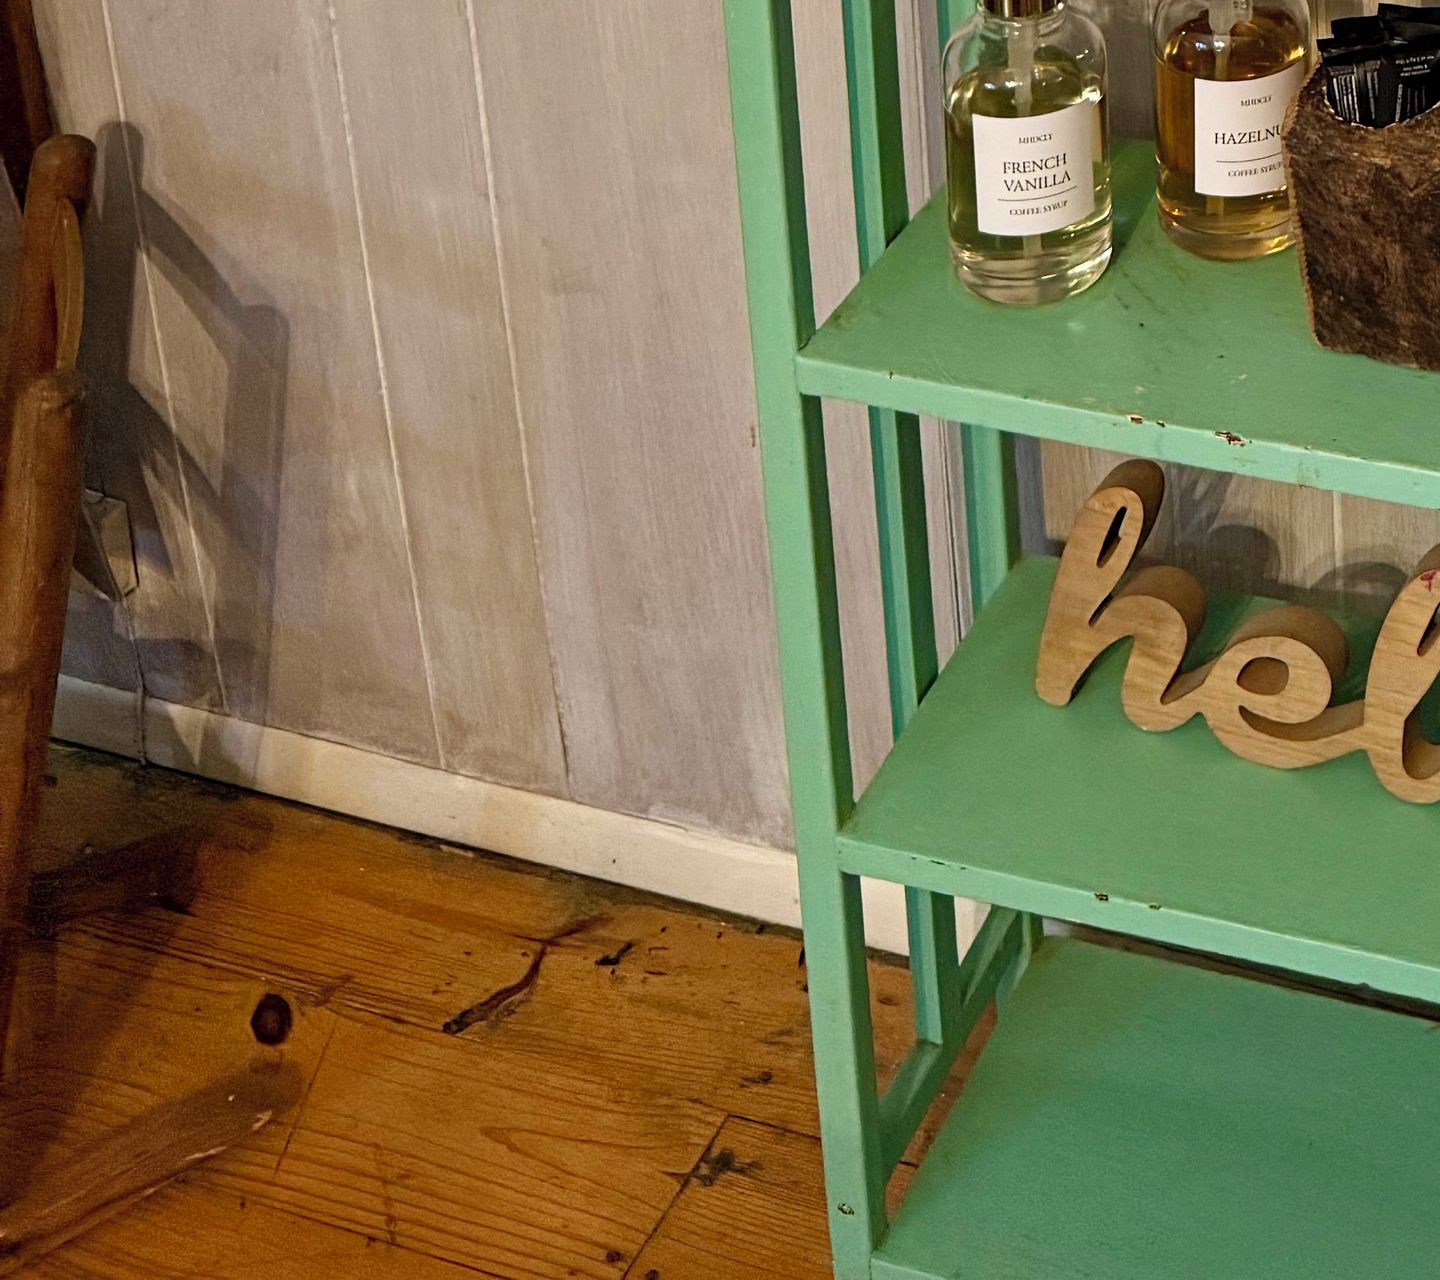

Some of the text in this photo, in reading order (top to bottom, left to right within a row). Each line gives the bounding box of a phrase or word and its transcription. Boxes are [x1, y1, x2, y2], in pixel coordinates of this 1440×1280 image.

[1215, 124, 1282, 145] HAZELNU
[1003, 153, 1067, 174] FRENCH
[1228, 167, 1259, 177] COFFEE
[1004, 170, 1071, 192] VANILLA
